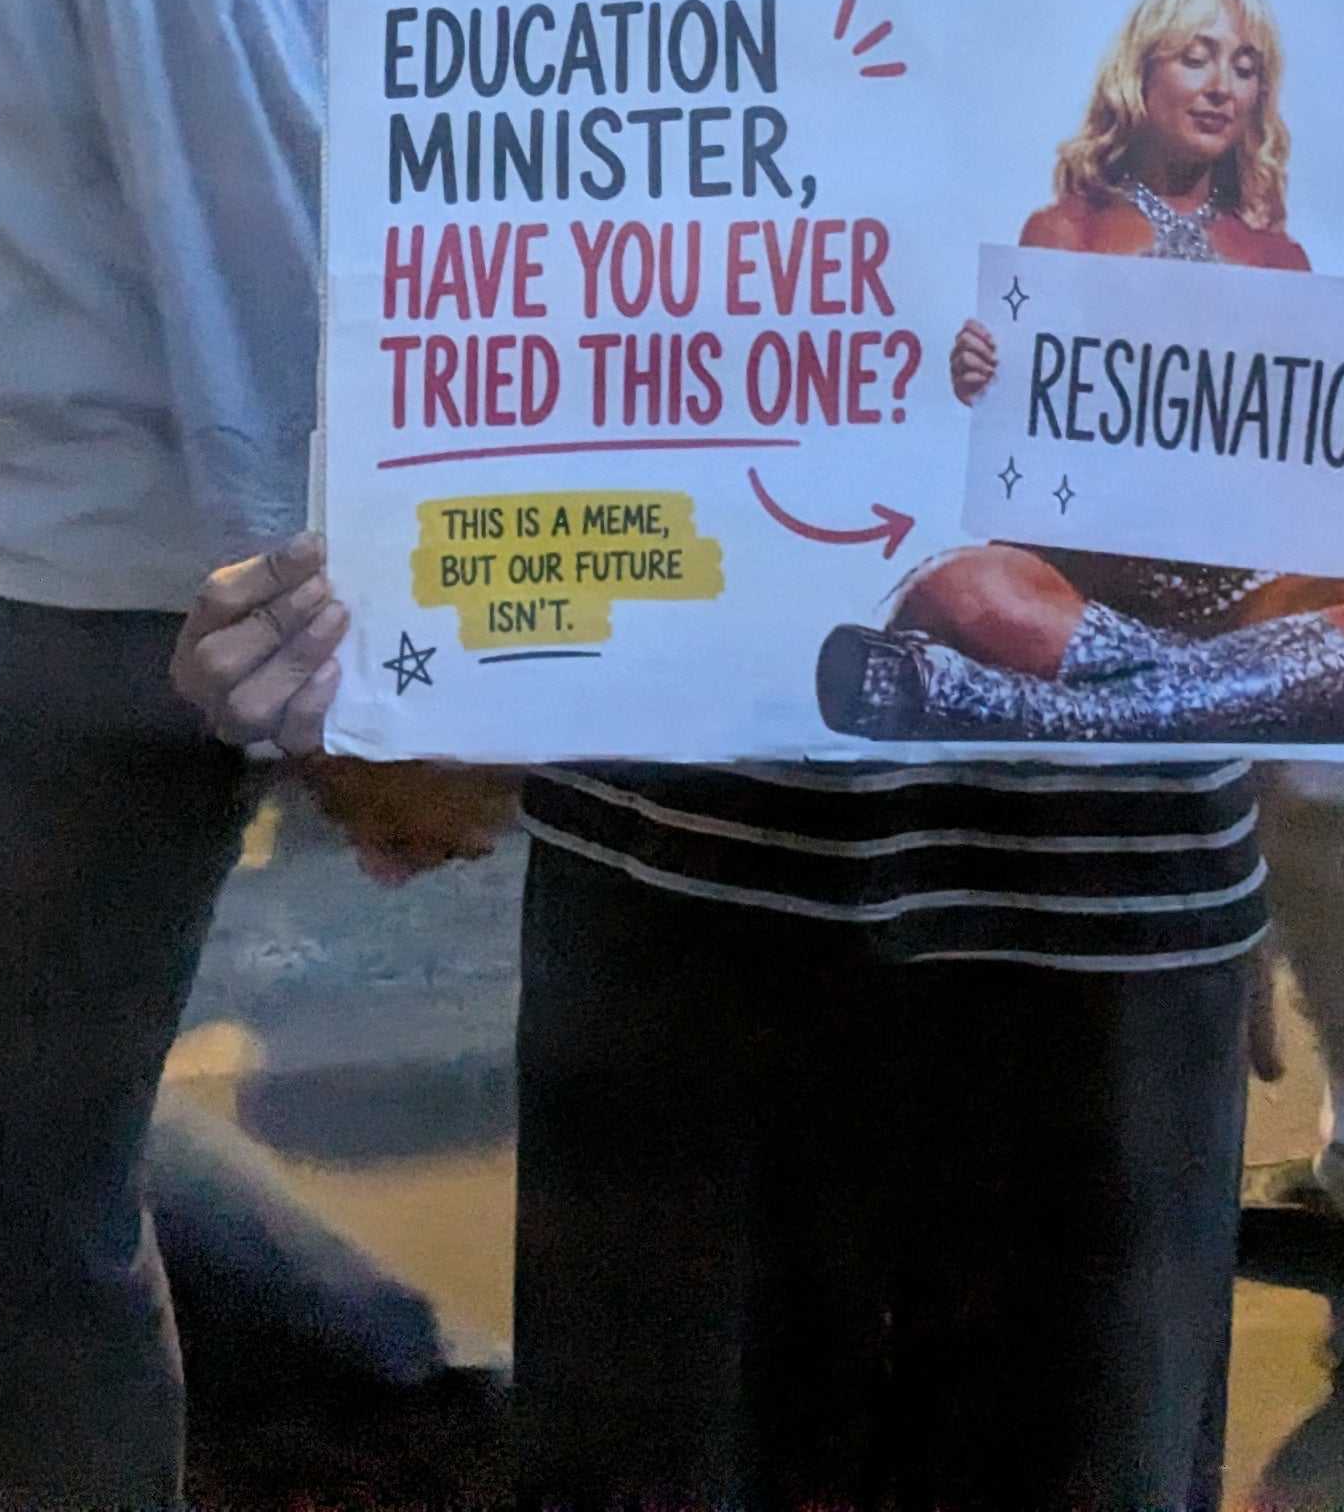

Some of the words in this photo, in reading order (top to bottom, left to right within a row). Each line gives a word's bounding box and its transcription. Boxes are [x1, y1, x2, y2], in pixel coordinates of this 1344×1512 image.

[388, 107, 818, 209] MINISTER,
[382, 221, 548, 320] HAVE
[570, 220, 700, 318] YOU
[726, 218, 895, 317] EVER
[380, 335, 560, 429] TRIED
[579, 332, 724, 427] THIS
[745, 330, 922, 427] ONE?
[442, 507, 506, 538] THIS
[515, 506, 540, 537] IS
[550, 505, 572, 536] A
[582, 504, 669, 539] MEME,
[441, 554, 497, 586] BUT
[508, 552, 564, 583] OUR
[576, 549, 683, 581] FUTURE
[488, 598, 574, 632] ISN'T.
